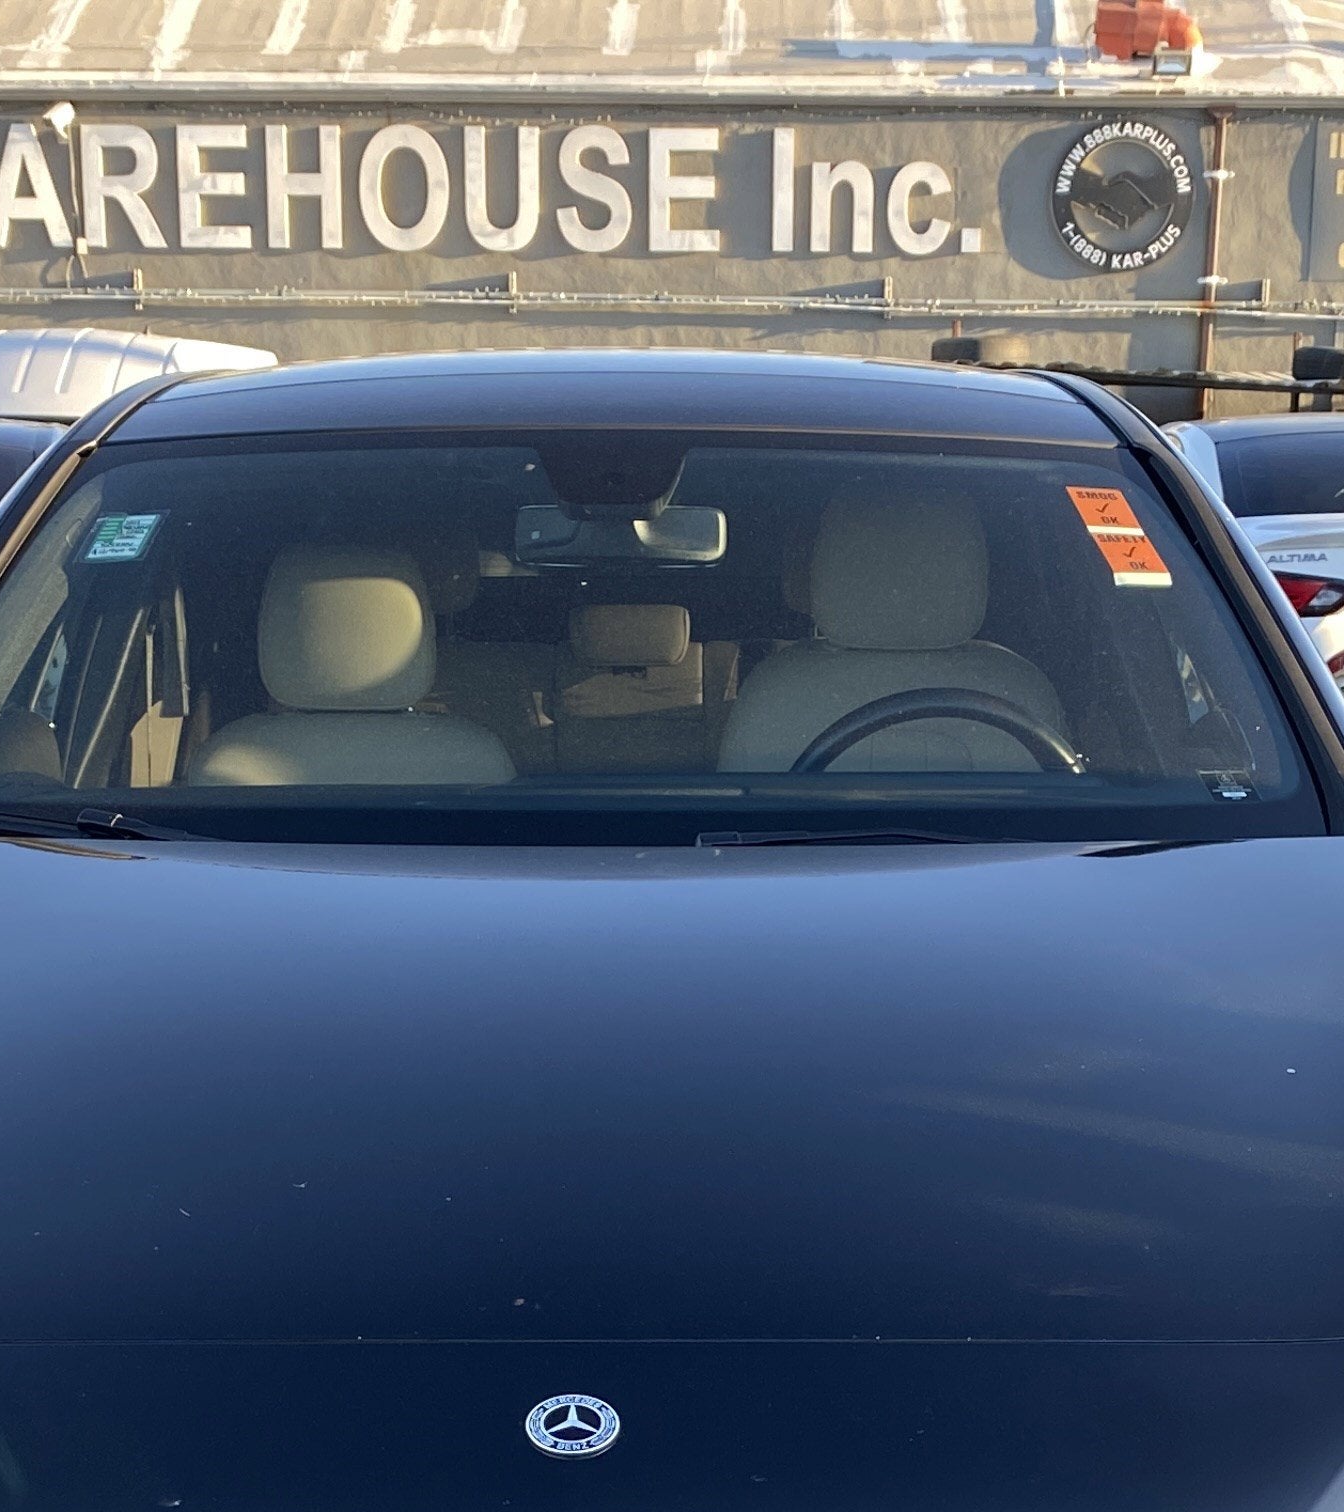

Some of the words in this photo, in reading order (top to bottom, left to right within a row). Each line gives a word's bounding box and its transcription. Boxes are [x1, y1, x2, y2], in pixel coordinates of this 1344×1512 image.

[1055, 121, 1192, 195] WWW.888KARPLUS.COM
[772, 126, 984, 256] Inc.
[1061, 222, 1107, 267] 1-(888)
[1110, 223, 1182, 270] KAR-PLUS
[1075, 490, 1119, 501] SMOG
[1100, 515, 1120, 524] OK
[1096, 534, 1147, 544] SAFETY
[1267, 552, 1328, 564] ALTIMA
[1129, 561, 1149, 570] OK
